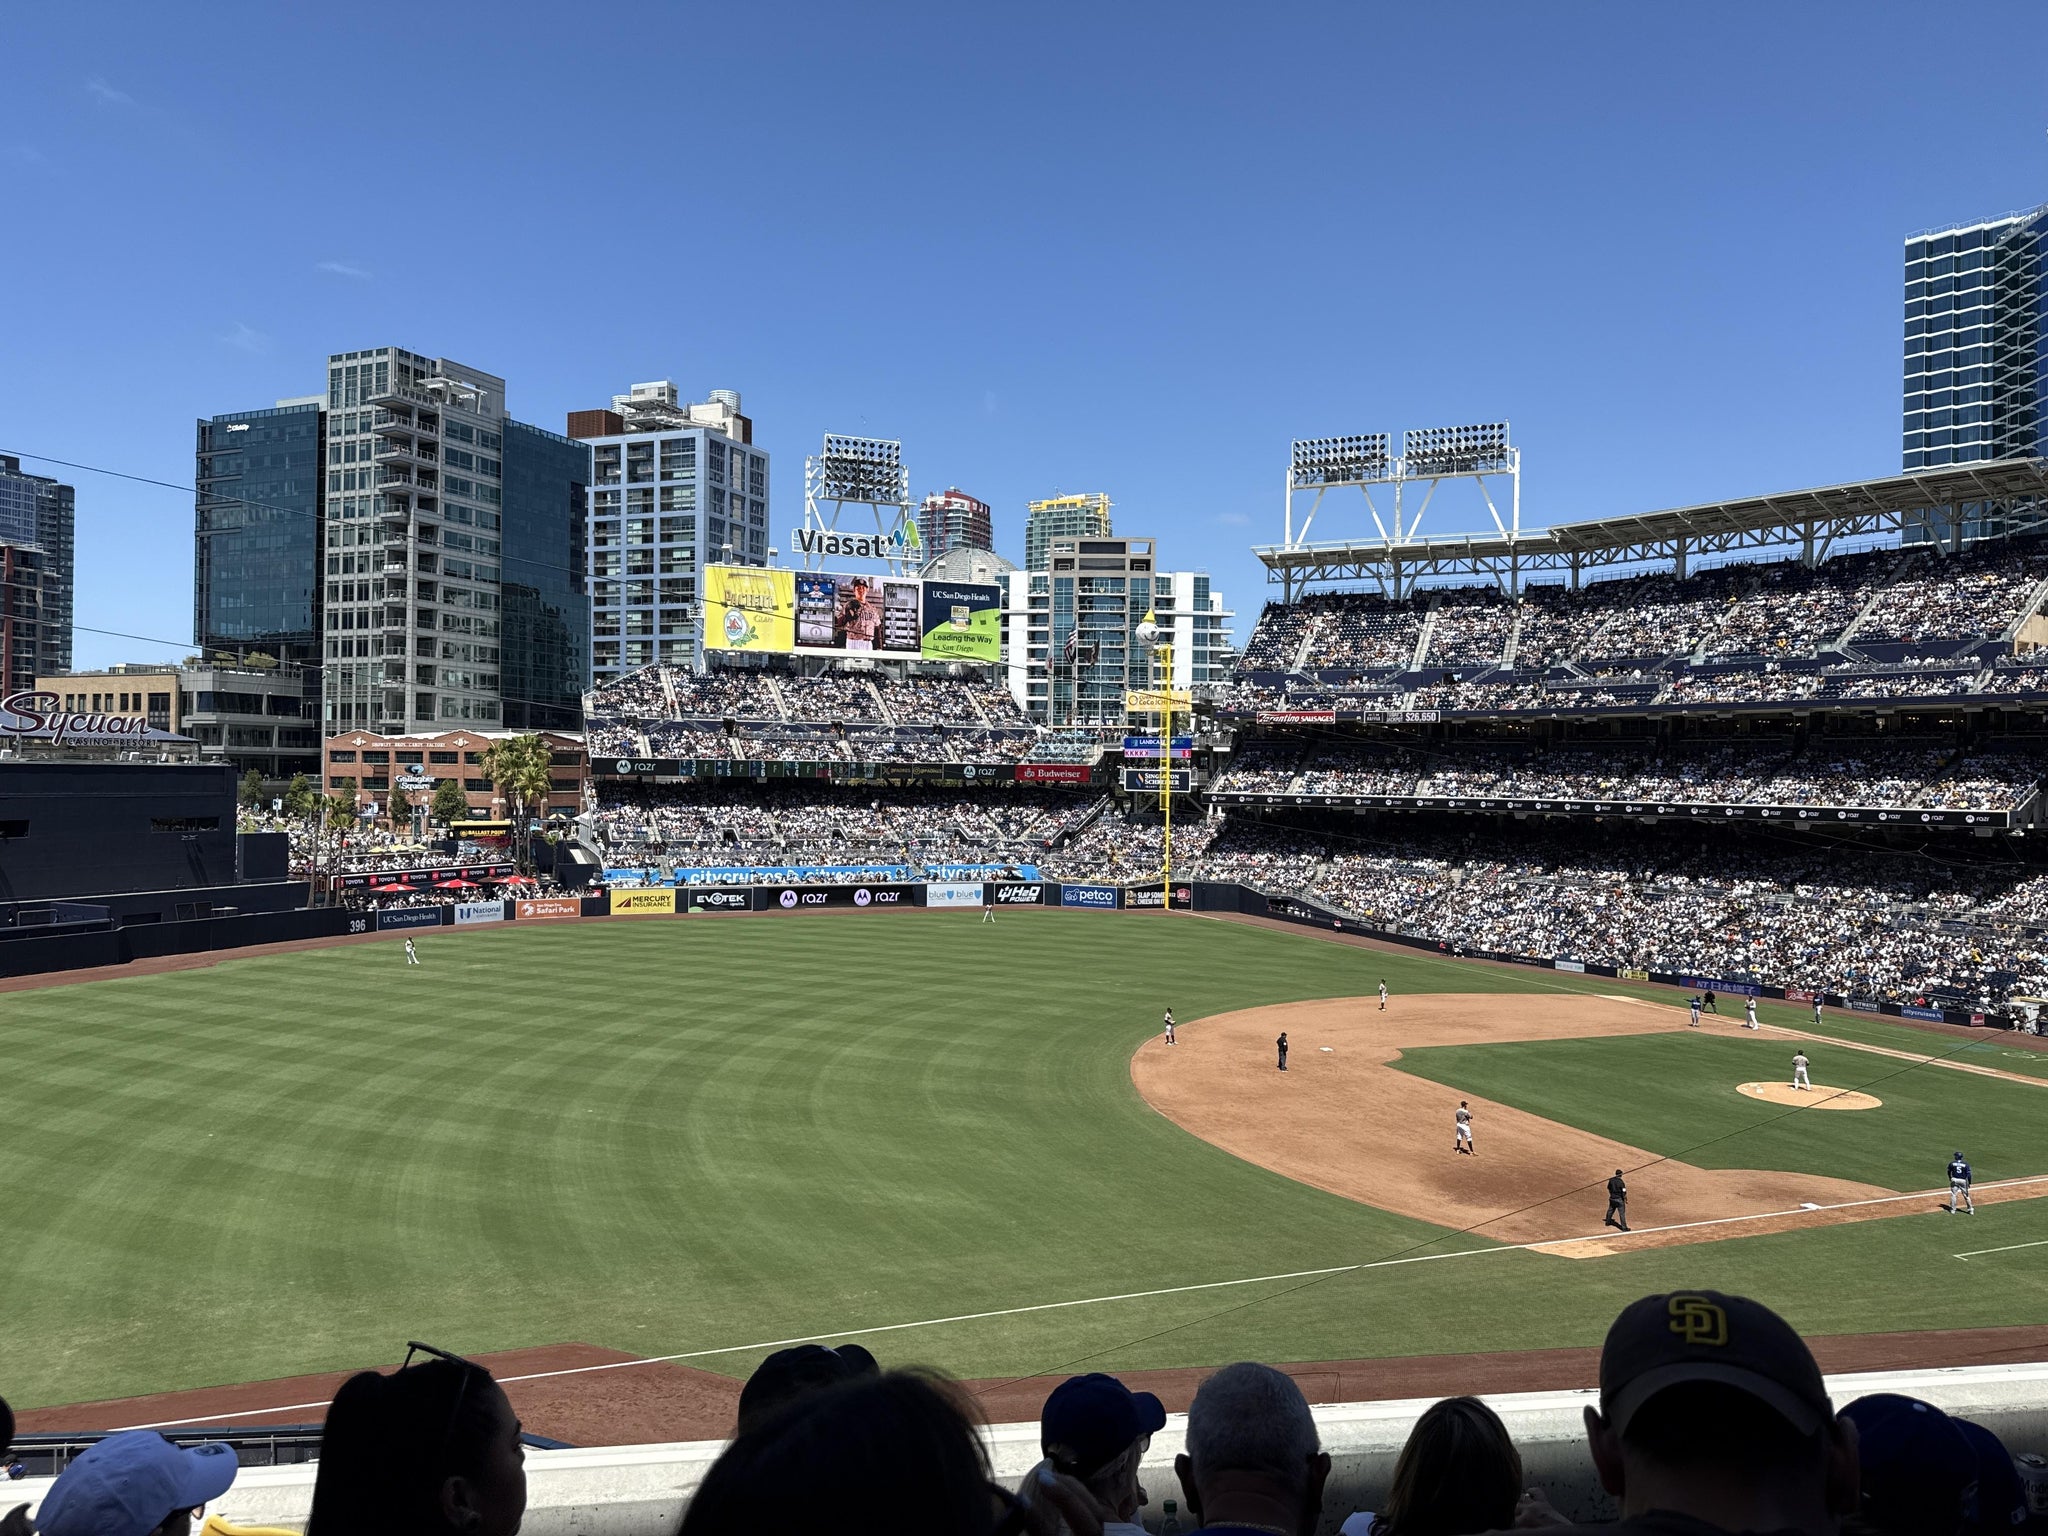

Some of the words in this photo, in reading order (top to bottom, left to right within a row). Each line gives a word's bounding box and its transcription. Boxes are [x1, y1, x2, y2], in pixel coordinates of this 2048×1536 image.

[798, 529, 884, 558] Viasat
[932, 590, 943, 598] UC
[954, 592, 970, 602] Diego
[972, 593, 990, 602] Health
[933, 633, 962, 642] Leading
[964, 634, 976, 642] the
[976, 635, 992, 644] Way
[956, 645, 974, 653] Diego
[0, 690, 152, 746] Sycuan
[1258, 713, 1300, 722] Tarantino
[1406, 712, 1436, 722] $26,650
[120, 738, 157, 746] RESORT
[704, 764, 708, 772] F
[739, 764, 743, 772] F
[774, 765, 777, 773] F
[806, 766, 810, 774] F
[1038, 768, 1080, 778] Budweiser
[395, 775, 436, 783] Gallagher
[401, 782, 430, 790] Square
[1012, 886, 1041, 896] H2O
[1080, 890, 1113, 902] petco
[696, 892, 745, 905] EVOTEK
[802, 893, 828, 904] razr
[875, 892, 900, 902] razr
[473, 904, 501, 914] National
[350, 919, 366, 932] 396
[1903, 1009, 1936, 1018] citycruises
[1668, 1295, 1728, 1346] SD
